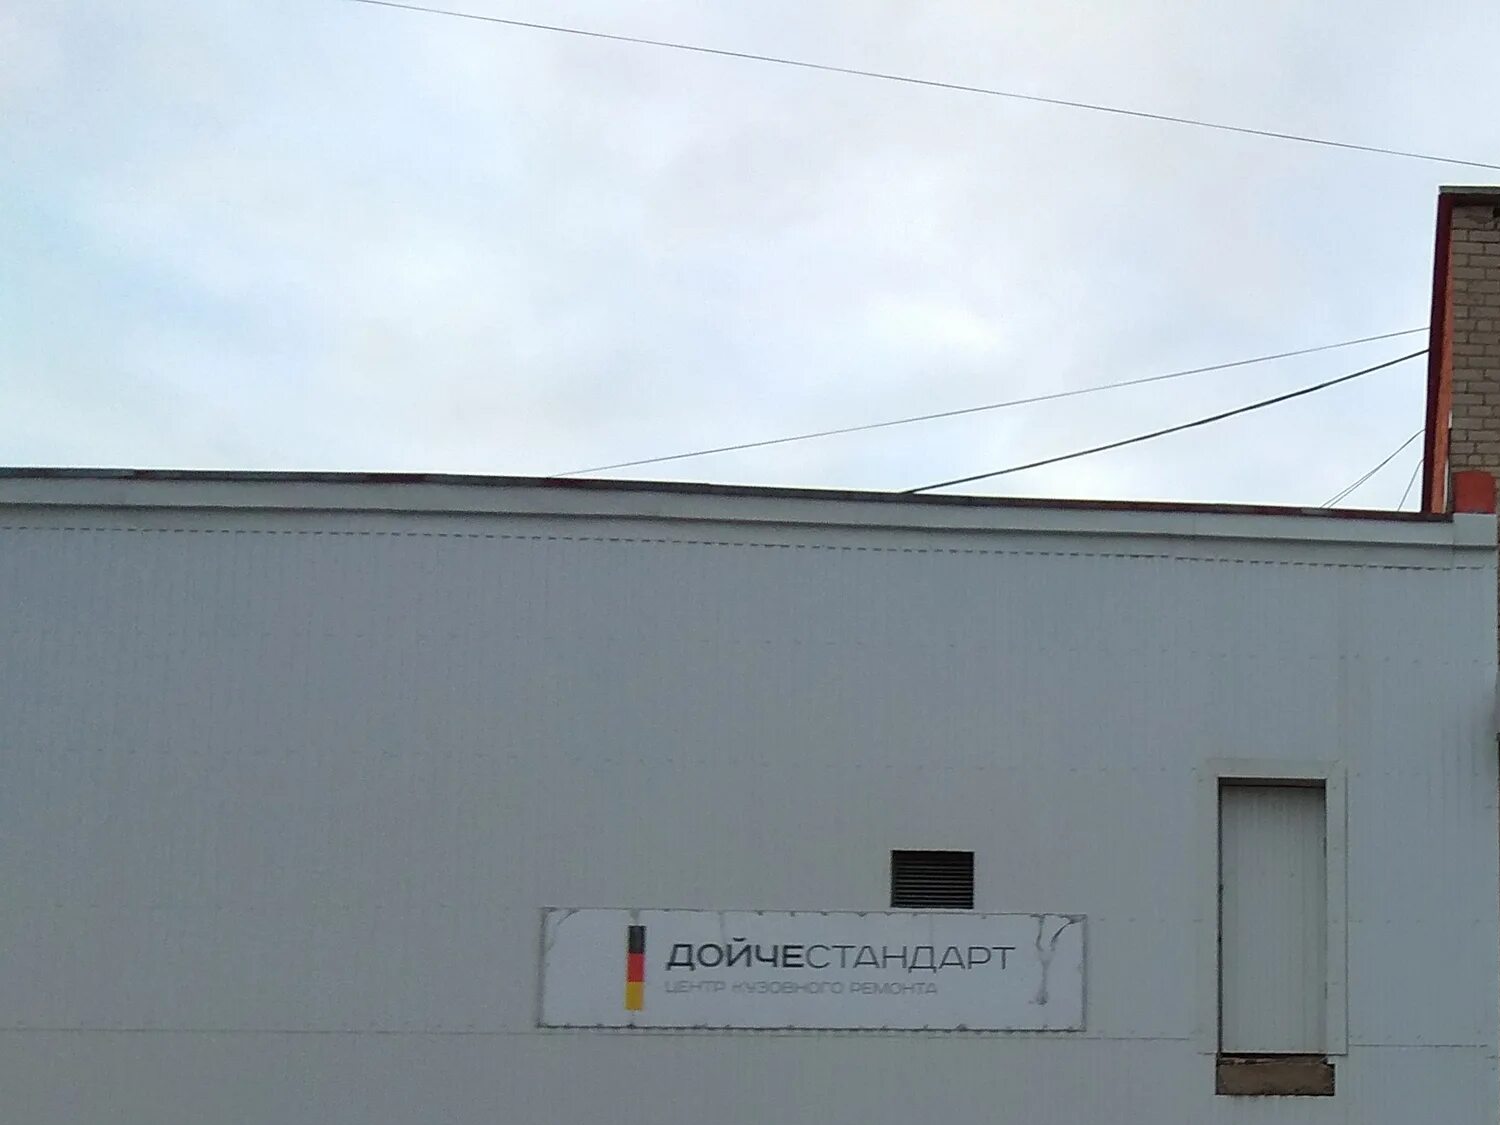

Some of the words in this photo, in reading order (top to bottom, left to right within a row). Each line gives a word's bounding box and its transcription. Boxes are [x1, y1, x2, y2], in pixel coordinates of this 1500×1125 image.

[665, 937, 1016, 973] ДОЙЧЕСТАНДАРТ
[664, 980, 726, 994] ЦЕНТР
[732, 981, 844, 995] КУЗОВНОГО
[850, 981, 939, 996] РЕМОНТА
